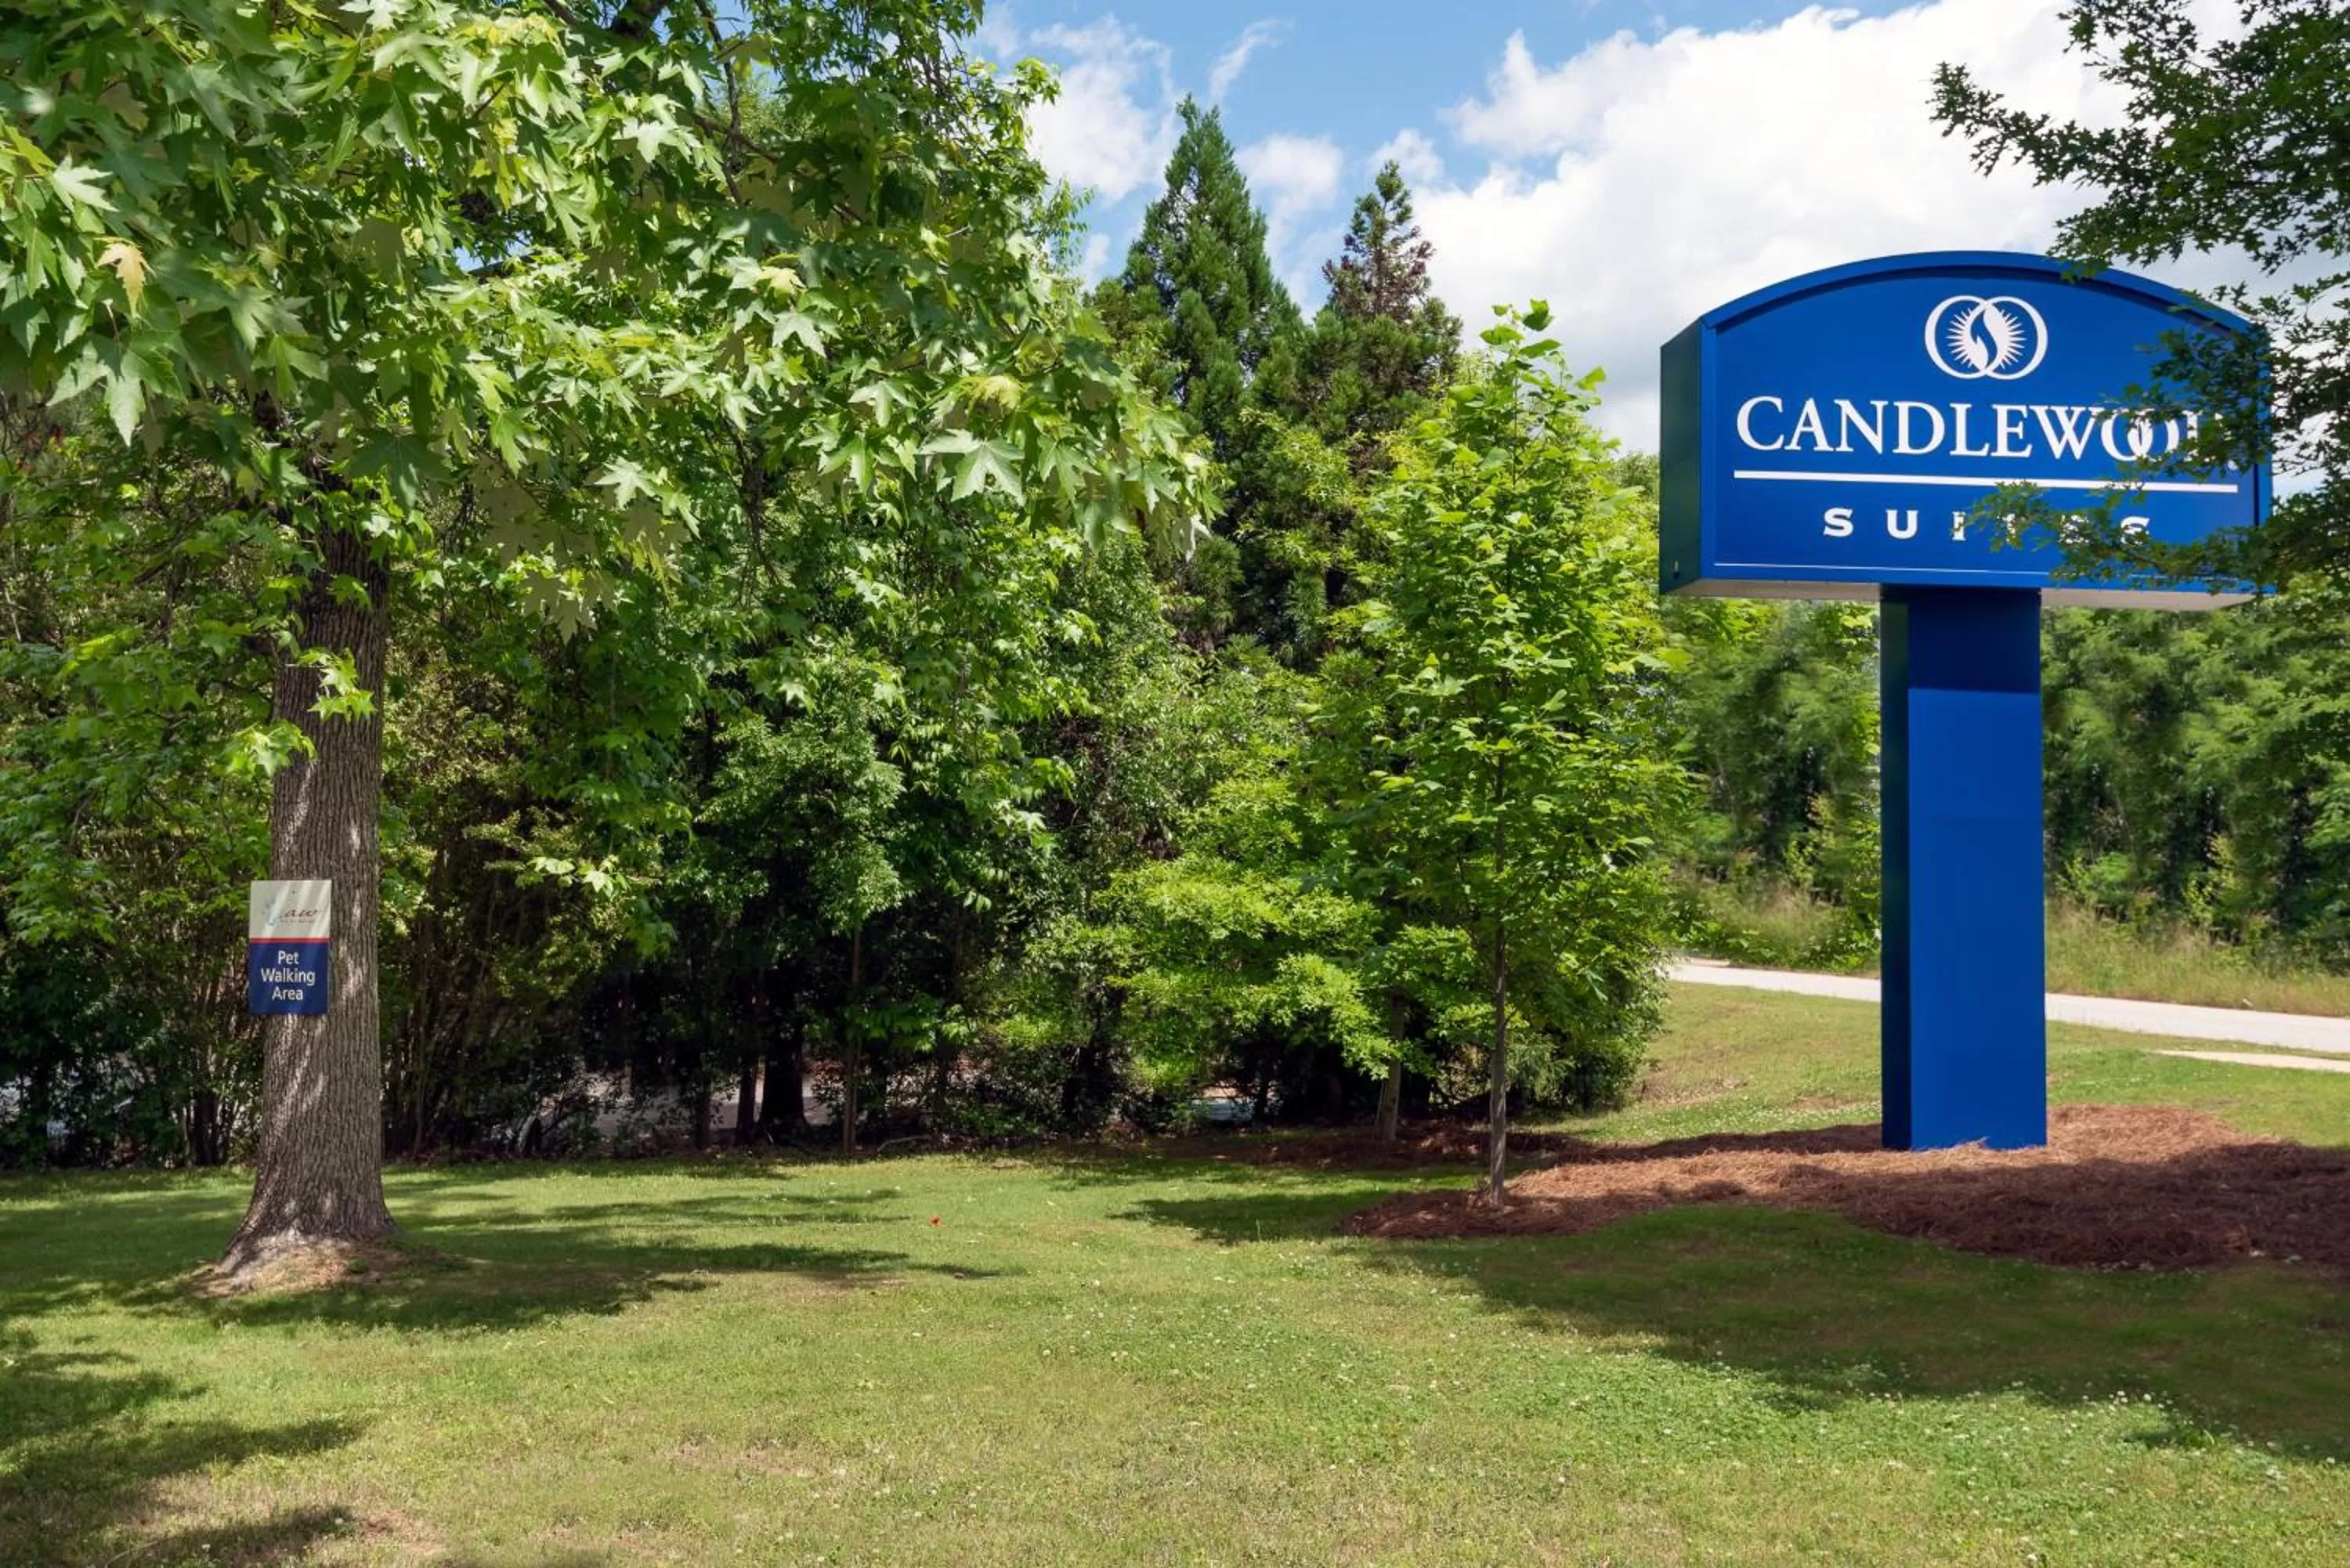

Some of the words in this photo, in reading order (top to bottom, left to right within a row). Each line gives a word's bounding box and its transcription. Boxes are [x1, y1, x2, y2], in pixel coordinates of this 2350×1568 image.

[277, 950, 299, 965] Pet
[261, 967, 316, 986] Walking
[272, 986, 303, 1000] Area
